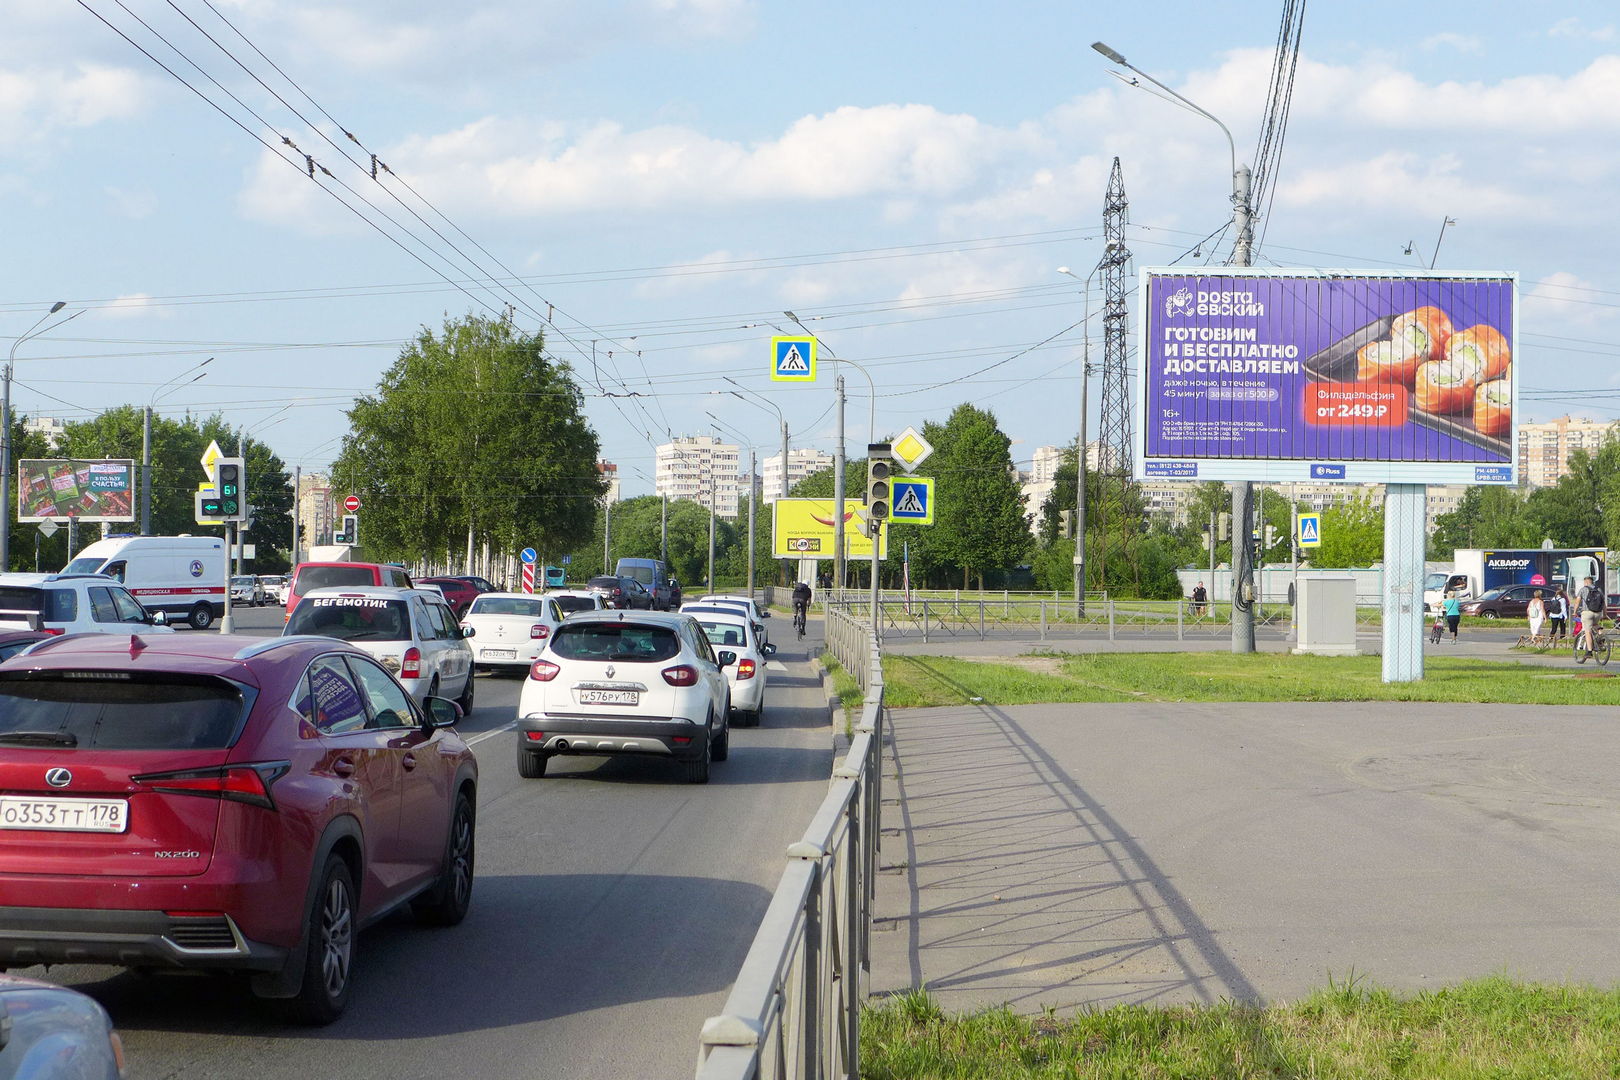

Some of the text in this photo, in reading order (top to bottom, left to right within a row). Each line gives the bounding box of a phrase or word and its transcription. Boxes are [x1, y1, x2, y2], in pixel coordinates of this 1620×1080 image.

[1164, 327, 1257, 341] ГОТОВИМ
[1164, 343, 1299, 359] И БЕСПЛАТНО
[1163, 359, 1299, 375] ДОСТАВЛЯЕМ
[1189, 380, 1220, 388] ночью,
[1163, 389, 1176, 398] 45
[1177, 390, 1205, 399] минут
[1210, 390, 1236, 398] заказ
[1317, 389, 1395, 401] Филадельфия
[1163, 409, 1180, 418] 16+
[1317, 406, 1336, 417] от
[91, 480, 125, 488] СЧАСТЬЯ!
[224, 485, 236, 495] 61
[1488, 559, 1529, 567] АКВАФОР
[313, 598, 388, 609] БЕГЕМОТИК
[584, 691, 635, 701] У576РУ 178
[5, 803, 119, 825] О353ТТ 178
